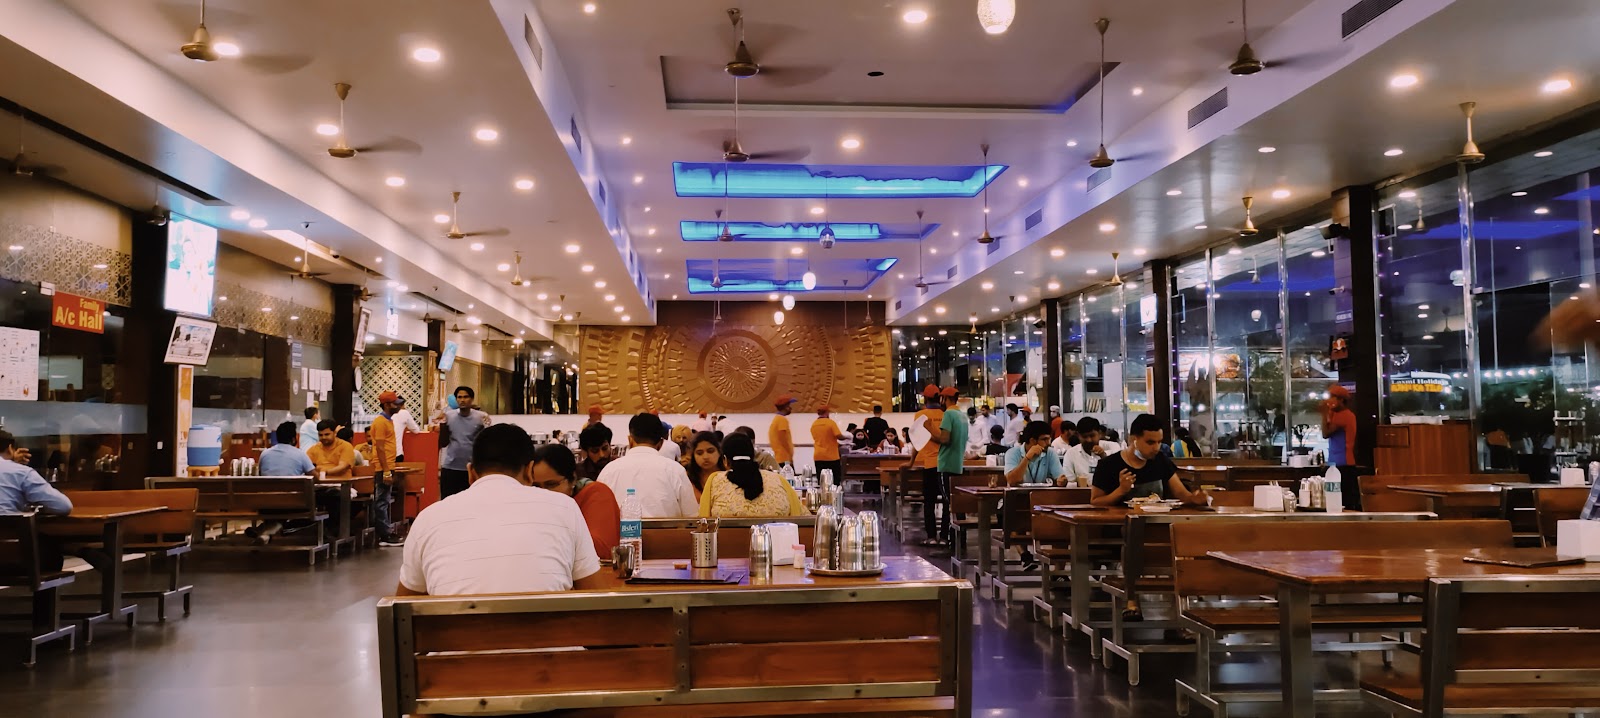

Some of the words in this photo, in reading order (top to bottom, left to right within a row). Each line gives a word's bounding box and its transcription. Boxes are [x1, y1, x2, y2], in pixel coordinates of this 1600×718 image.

[80, 298, 99, 313] Family
[55, 306, 75, 325] A/c
[79, 310, 102, 330] Hall
